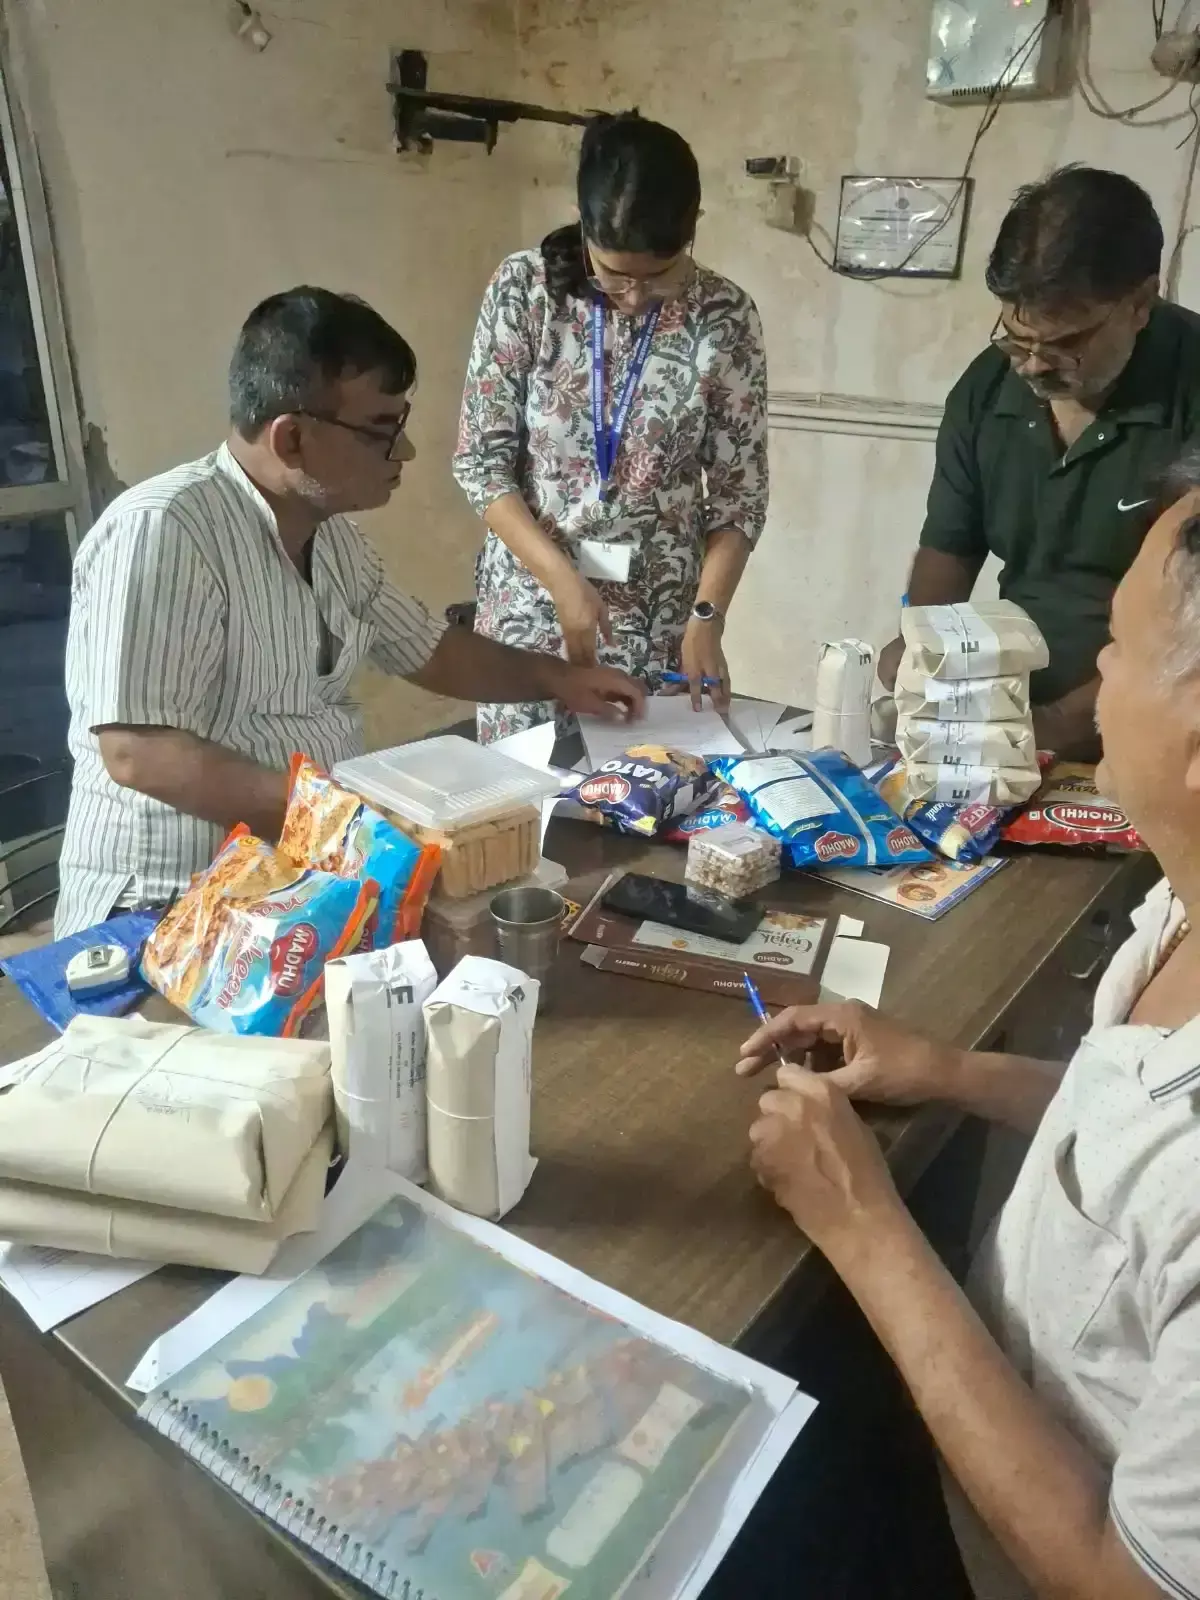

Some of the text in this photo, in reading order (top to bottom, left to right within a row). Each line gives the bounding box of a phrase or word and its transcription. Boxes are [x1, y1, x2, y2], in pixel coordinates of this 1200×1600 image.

[684, 812, 732, 827] MADHU
[1060, 807, 1123, 823] CHOKHI
[821, 837, 857, 856] MADHU
[278, 927, 310, 990] MADHU
[756, 953, 792, 964] MADHU
[713, 979, 747, 989] MADHU
